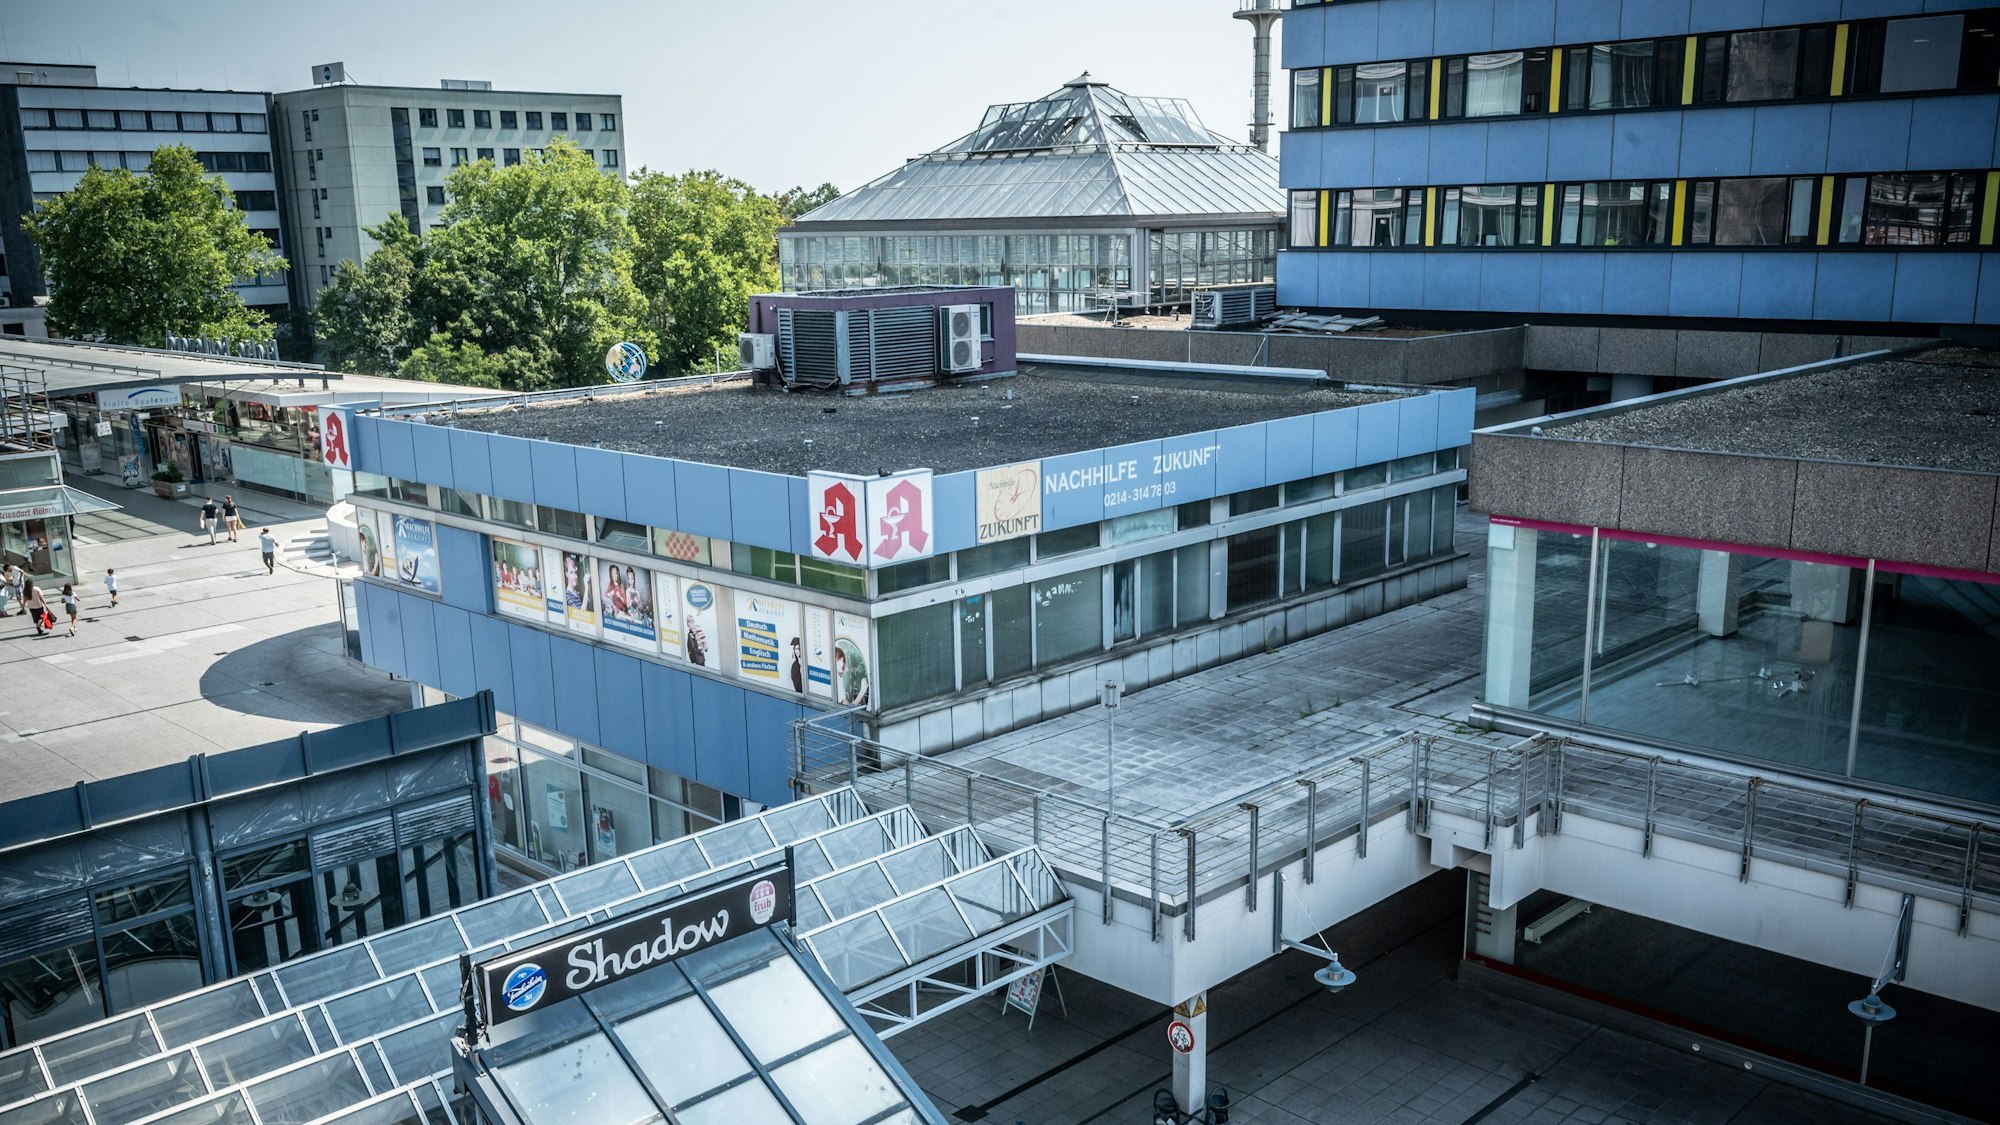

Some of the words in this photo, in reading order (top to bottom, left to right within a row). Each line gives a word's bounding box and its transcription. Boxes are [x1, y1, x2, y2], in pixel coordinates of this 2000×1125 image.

[103, 400, 130, 408] Rialto
[134, 396, 178, 406] Boulevard
[1045, 460, 1138, 494] NACHHILFE
[1153, 444, 1221, 475] ZUKUNFT
[1150, 484, 1162, 498] 78
[1164, 481, 1176, 494] 03
[406, 522, 431, 535] NACHHILFE
[980, 514, 1040, 540] ZUKUNFT
[746, 621, 768, 630] Deutsch
[744, 632, 776, 647] Mathematik
[749, 647, 772, 658] Englisch
[566, 909, 730, 990] Shadow
